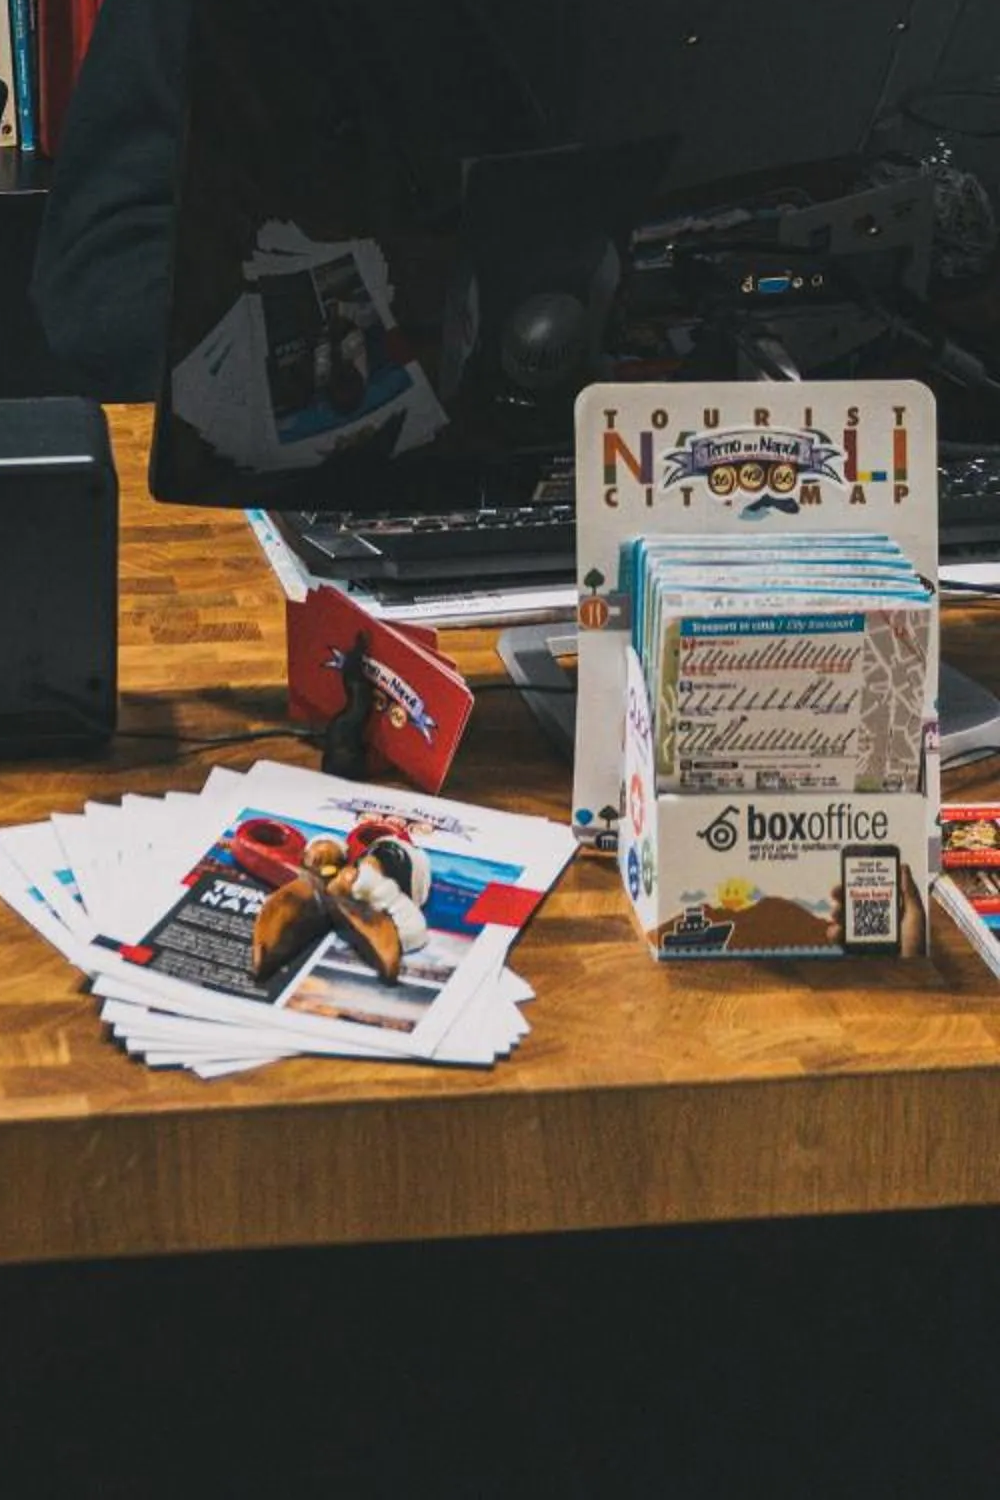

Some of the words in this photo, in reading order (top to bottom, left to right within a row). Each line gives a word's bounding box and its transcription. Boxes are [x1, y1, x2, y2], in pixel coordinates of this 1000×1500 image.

[603, 406, 906, 429] TOURIST
[604, 486, 733, 507] CIT
[799, 484, 909, 506] MAP
[747, 803, 889, 842] boxoffice
[214, 879, 266, 902] TERN
[200, 890, 263, 915] NAP
